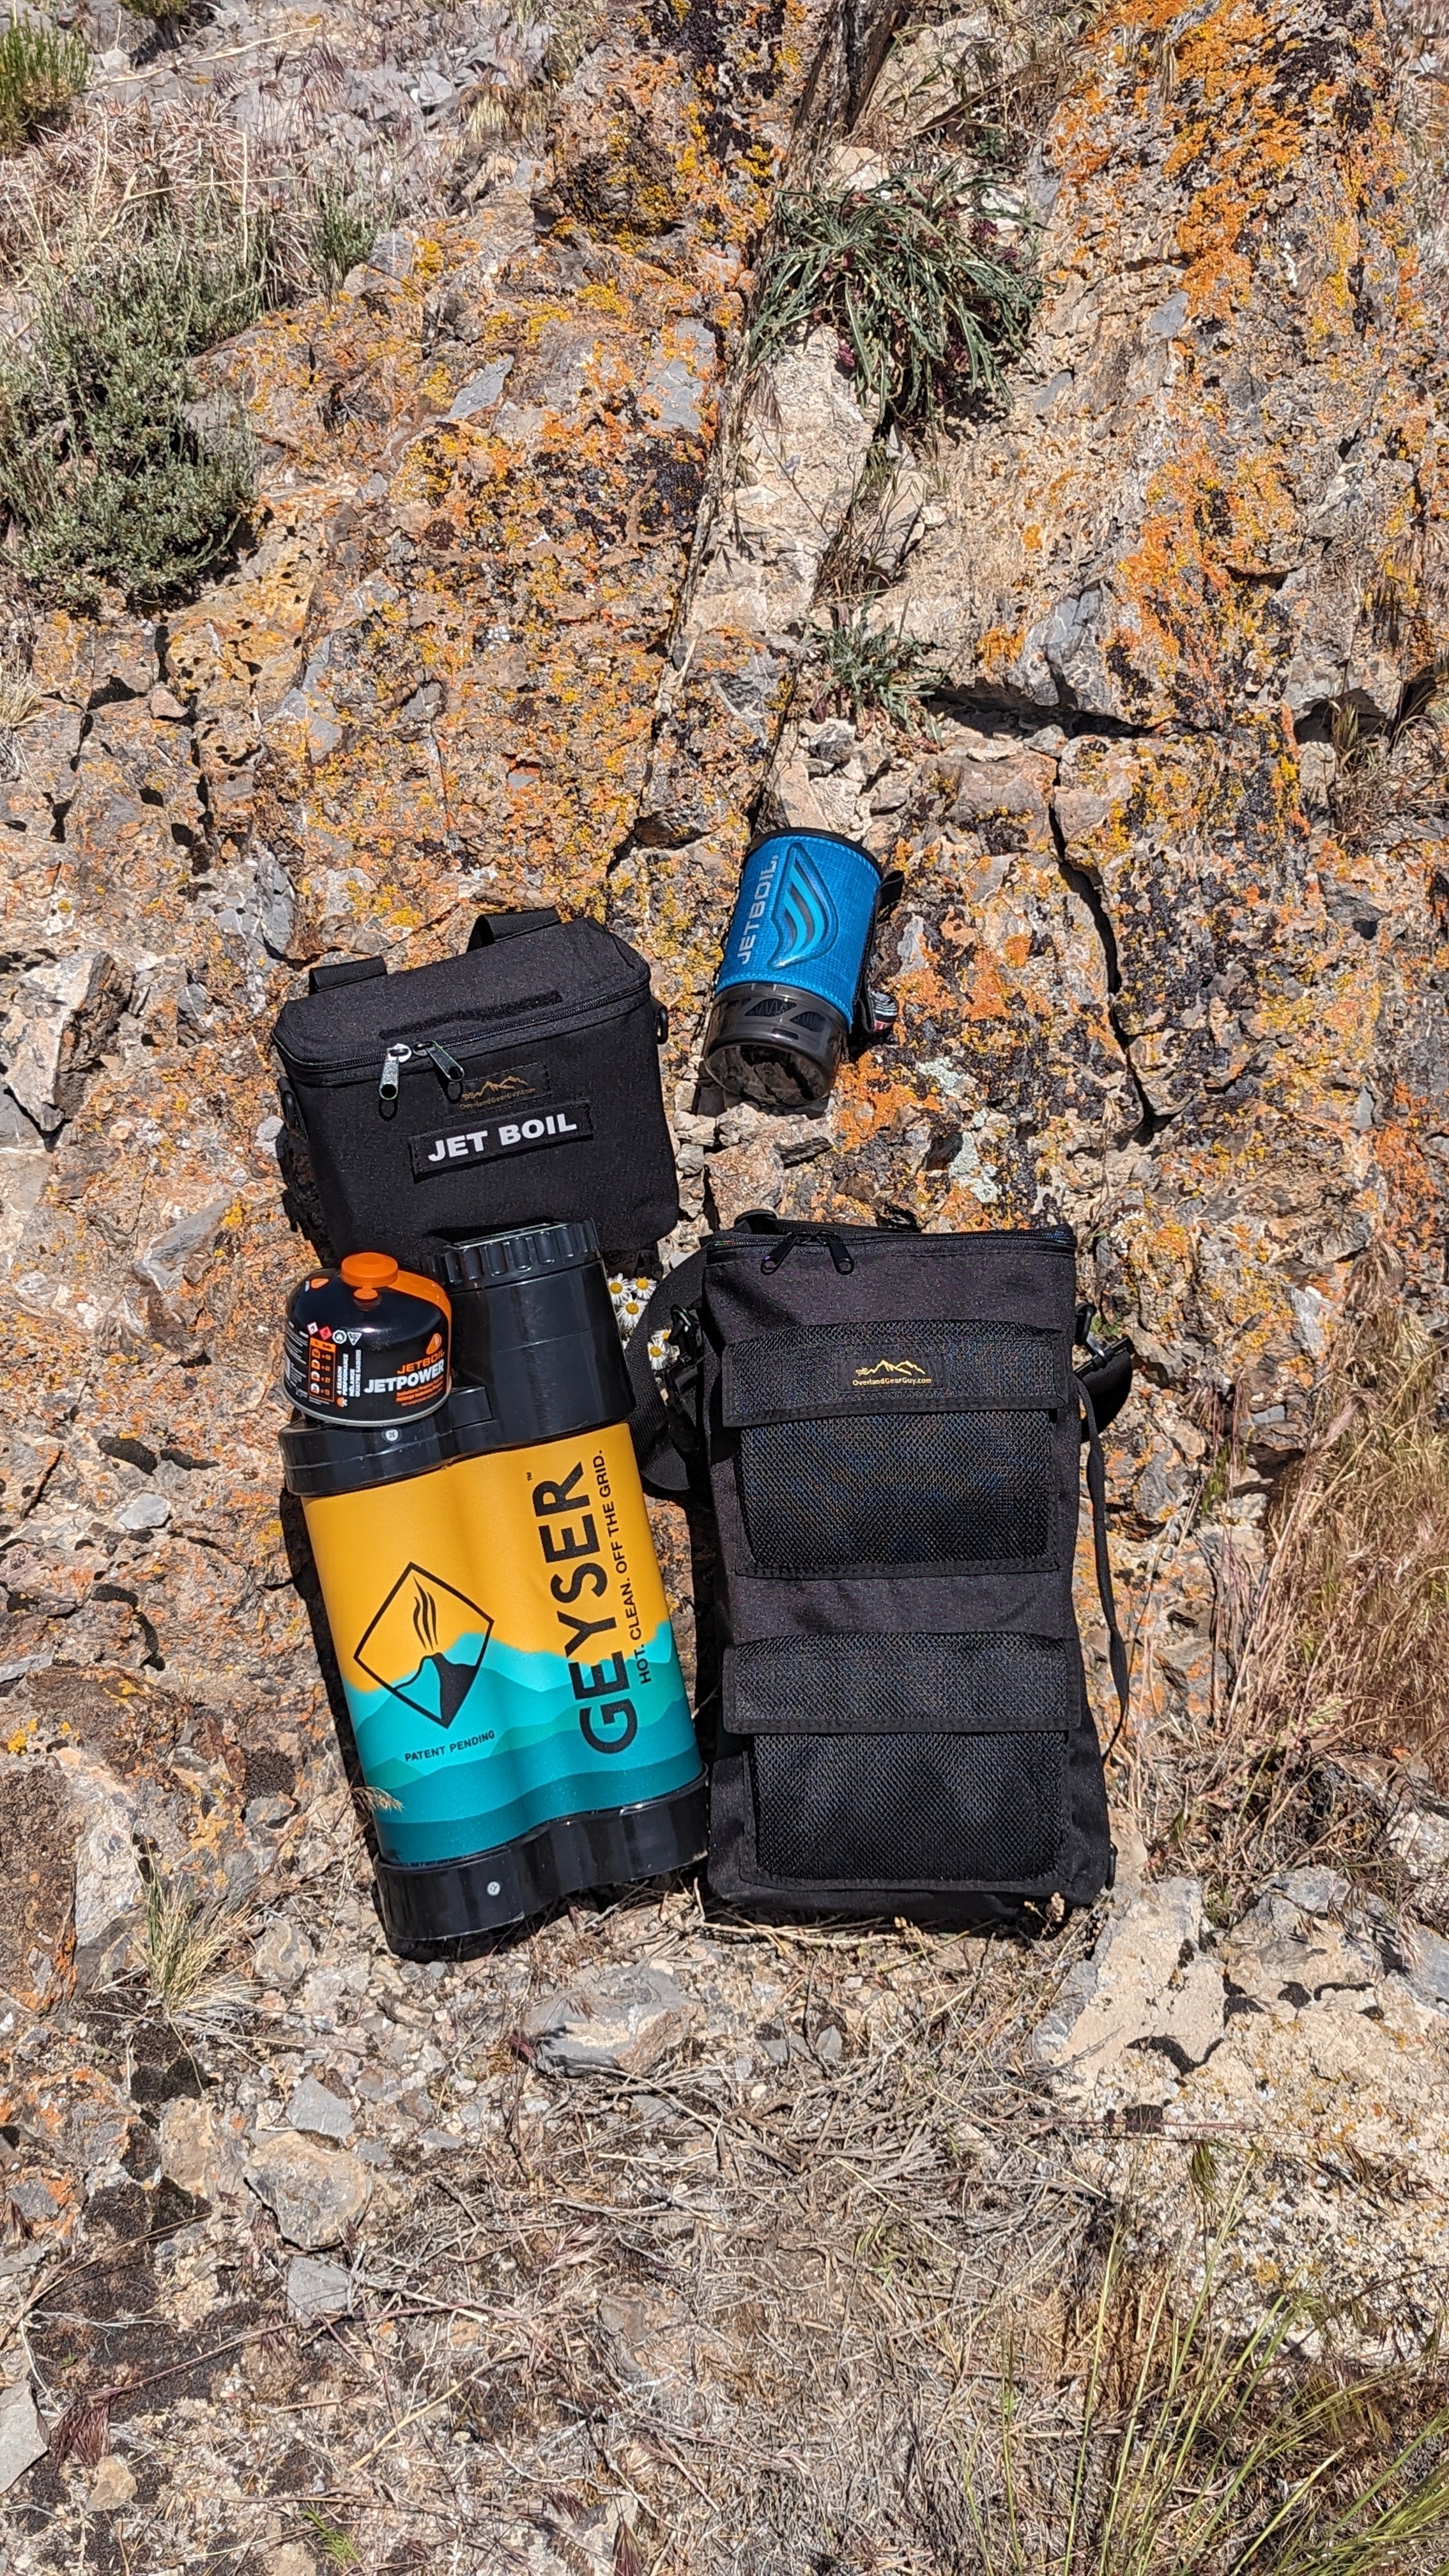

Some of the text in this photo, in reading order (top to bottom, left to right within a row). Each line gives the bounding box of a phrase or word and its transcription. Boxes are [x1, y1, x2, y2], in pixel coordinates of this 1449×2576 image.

[428, 1113, 578, 1162] JET BOIL
[364, 1358, 445, 1393] JETPOWER
[397, 1349, 445, 1374] JETBOIL
[852, 1377, 931, 1386] OverlandGearGuy.com
[593, 1450, 652, 1684] HOT. CLEAN. OFF THE GRID.
[532, 1461, 638, 1754] GEYSER
[404, 1729, 495, 1762] PATENT PENDING
